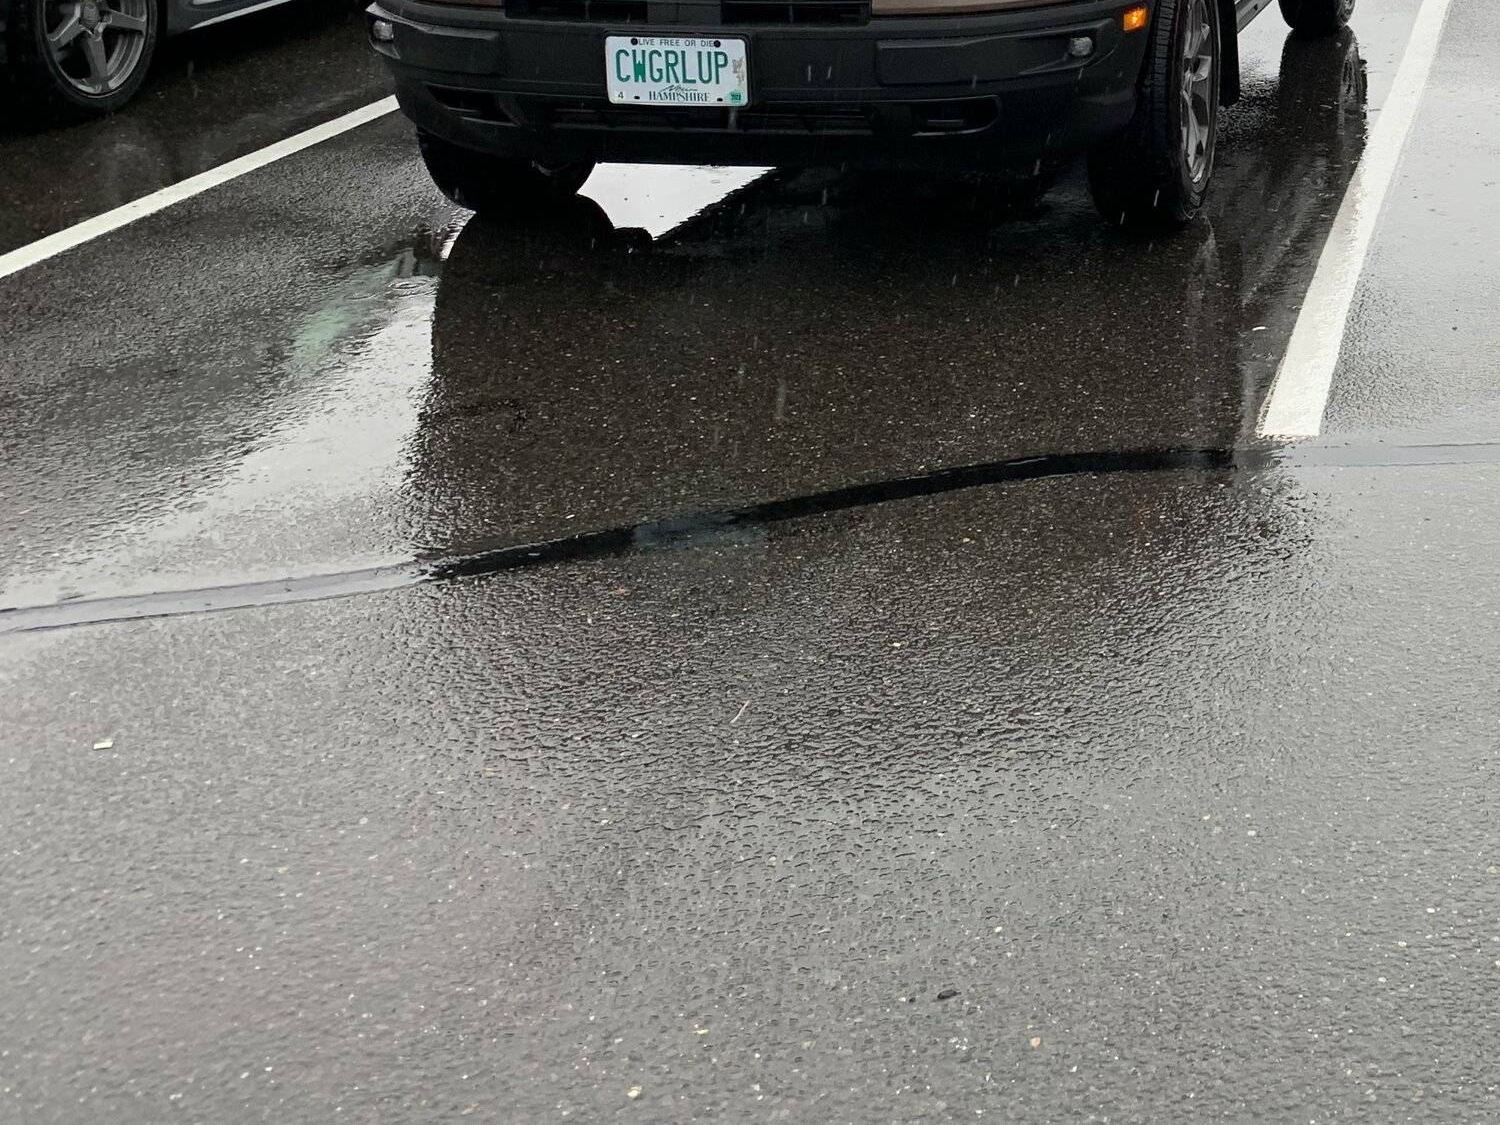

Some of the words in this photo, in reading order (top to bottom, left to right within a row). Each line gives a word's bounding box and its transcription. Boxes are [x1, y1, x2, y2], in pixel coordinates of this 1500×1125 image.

[660, 39, 680, 47] FREE
[684, 39, 696, 47] OR
[615, 48, 729, 85] CWGRLUP
[617, 91, 624, 99] 4
[648, 91, 711, 102] HAMPSHIRE
